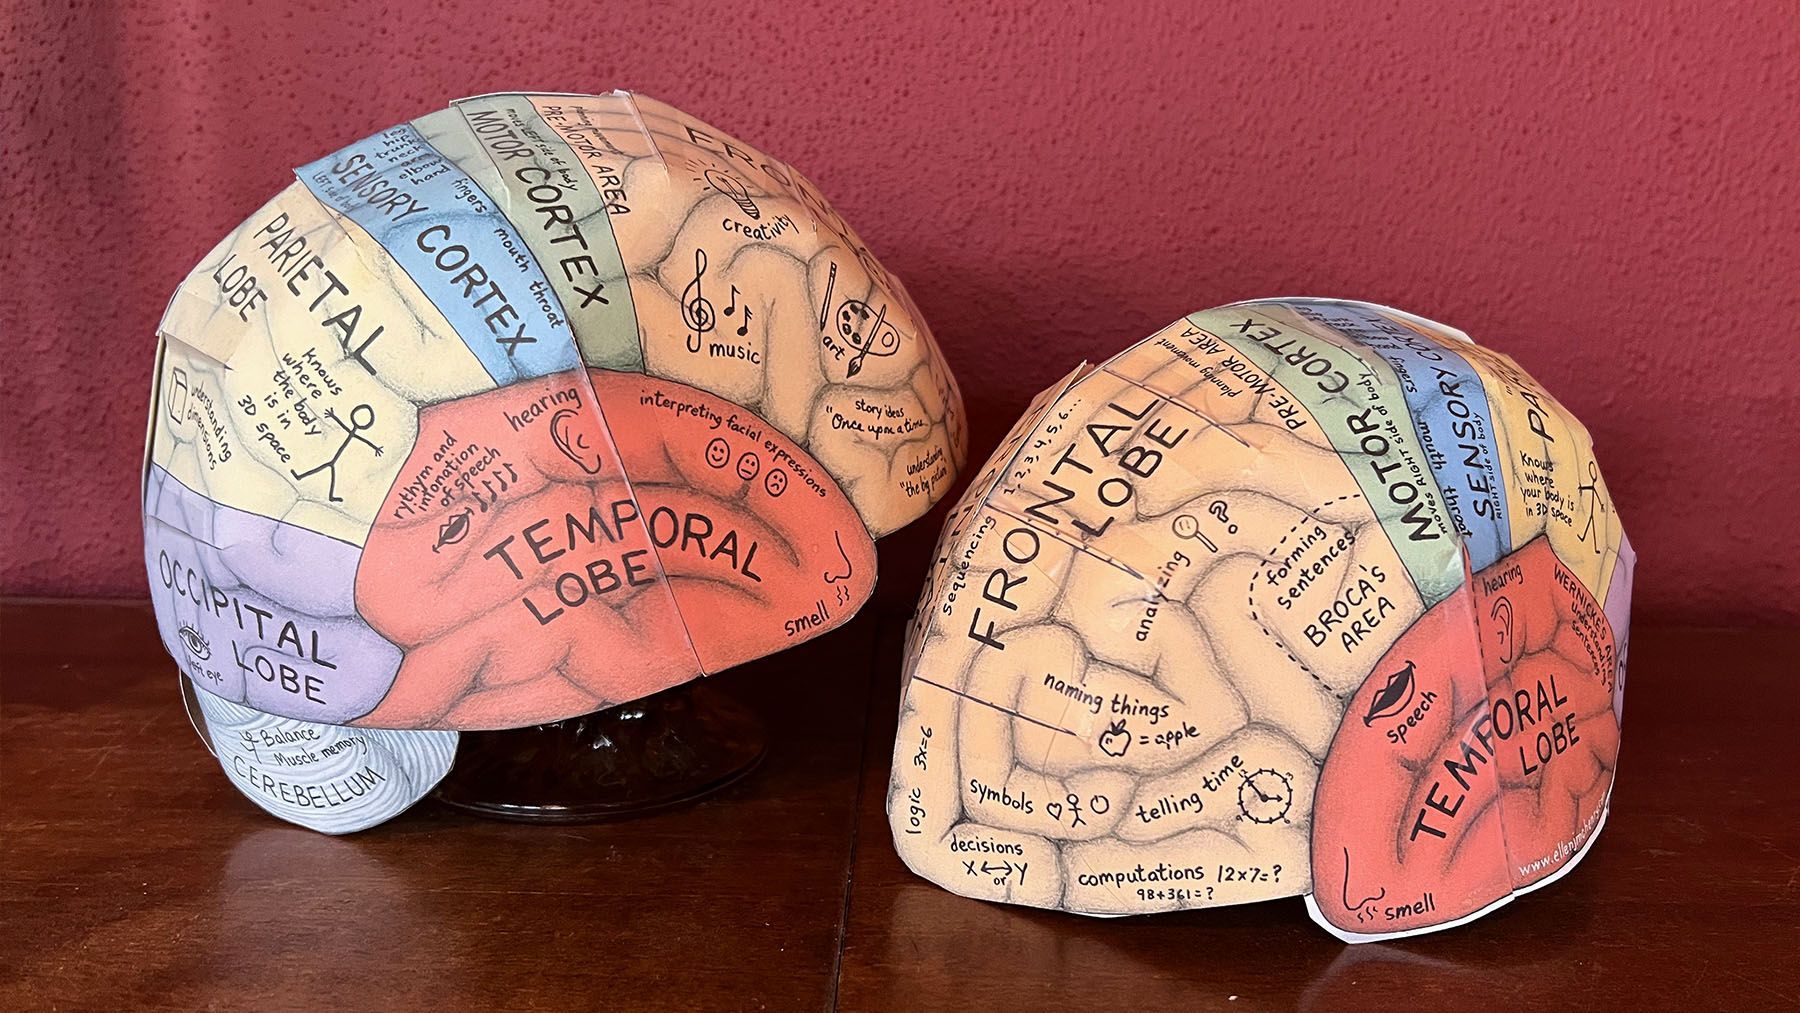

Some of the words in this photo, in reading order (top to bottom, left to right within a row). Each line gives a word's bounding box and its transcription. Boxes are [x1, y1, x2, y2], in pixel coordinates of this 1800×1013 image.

[374, 139, 422, 160] trunk
[383, 135, 410, 147] hip
[387, 145, 423, 163] neck
[400, 152, 432, 168] arm
[542, 106, 602, 160] PRE-MOTOR
[592, 165, 631, 216] AREA
[399, 157, 444, 181] elbow
[410, 164, 451, 186] hand
[550, 157, 567, 167] of
[556, 167, 579, 191] body
[467, 110, 534, 161] MOTOR
[515, 168, 609, 308] CORTEX
[722, 213, 800, 240] creativity
[331, 154, 429, 222] SENSORY
[416, 225, 538, 357] CORTEX
[452, 179, 488, 213] fingers
[493, 229, 528, 273] mouth
[529, 281, 564, 329] throat
[213, 254, 268, 322] LOBE
[253, 212, 384, 376] PARIETAL
[709, 341, 761, 365] music
[822, 336, 846, 360] art
[1154, 338, 1201, 369] movement
[1180, 327, 1226, 356] AREA
[1229, 318, 1349, 394] CORTEX
[282, 353, 321, 399] where
[1200, 367, 1243, 398] planning
[1221, 355, 1307, 431] PRE-MOTOR
[1356, 372, 1380, 402] body
[1388, 356, 1418, 394] fingers
[264, 391, 275, 408] is
[277, 414, 291, 430] in
[273, 370, 293, 398] the
[293, 397, 321, 436] body
[503, 387, 583, 432] hearing
[855, 398, 882, 420] story
[884, 403, 905, 418] ideas
[1371, 404, 1388, 418] of
[238, 395, 256, 416] 3D
[256, 422, 291, 463] space
[640, 390, 722, 429] interpreting
[726, 415, 761, 442] facial
[764, 440, 826, 497] expressions
[897, 425, 904, 434] a
[1385, 420, 1404, 445] side
[1418, 421, 1448, 471] mouth
[1430, 366, 1496, 521] SENSORY
[1473, 412, 1486, 440] body
[1399, 450, 1427, 487] RIGHT
[1479, 443, 1489, 455] of
[394, 465, 433, 519] rythym
[433, 430, 457, 462] and
[418, 443, 479, 511] intonation
[441, 488, 455, 507] of
[455, 446, 501, 490] speech
[1072, 418, 1189, 537] LOBE
[1346, 408, 1441, 542] MOTOR
[1484, 458, 1496, 482] side
[1525, 470, 1555, 488] where
[1425, 493, 1448, 535] moves
[1443, 484, 1473, 538] throat
[1489, 483, 1502, 519] RIGHT
[1520, 487, 1542, 507] your
[1544, 485, 1564, 510] body
[1567, 494, 1575, 511] is
[1526, 502, 1534, 517] in
[1536, 502, 1548, 517] 3D
[1551, 508, 1572, 528] space
[483, 499, 762, 582] TEMPORAL
[968, 399, 1160, 651] FRONTAL
[942, 515, 997, 616] sequencing
[1267, 526, 1327, 586] forming
[1277, 531, 1356, 610] sentences
[522, 549, 657, 626] LOBE
[1136, 550, 1191, 642] analyzing
[1482, 562, 1524, 597] hearing
[160, 550, 337, 670] OCCIPITAL
[785, 599, 830, 637] smell
[1303, 564, 1386, 648] BROCA'S
[1554, 563, 1607, 641] WERNICKE'S
[1341, 596, 1396, 654] AREA
[207, 670, 224, 686] eye
[232, 640, 326, 705] LOBE
[1043, 673, 1103, 714] naming
[1111, 694, 1169, 725] things
[1387, 690, 1438, 744] speech
[260, 727, 320, 748] Balance
[274, 748, 319, 767] Muscle
[321, 736, 367, 759] memory
[1155, 722, 1201, 750] apple
[1519, 712, 1580, 776] LOBE
[1410, 674, 1568, 842] TEMPORAL
[233, 756, 386, 808] CEREBELLUM
[970, 779, 1034, 815] symbols
[1135, 792, 1204, 823] telling
[1202, 754, 1244, 793] time
[906, 787, 927, 834] logic
[951, 833, 1023, 856] decisions
[993, 876, 1007, 886] or
[1014, 862, 1029, 886] Y
[1079, 864, 1205, 889] computations
[1385, 892, 1436, 921] smell
